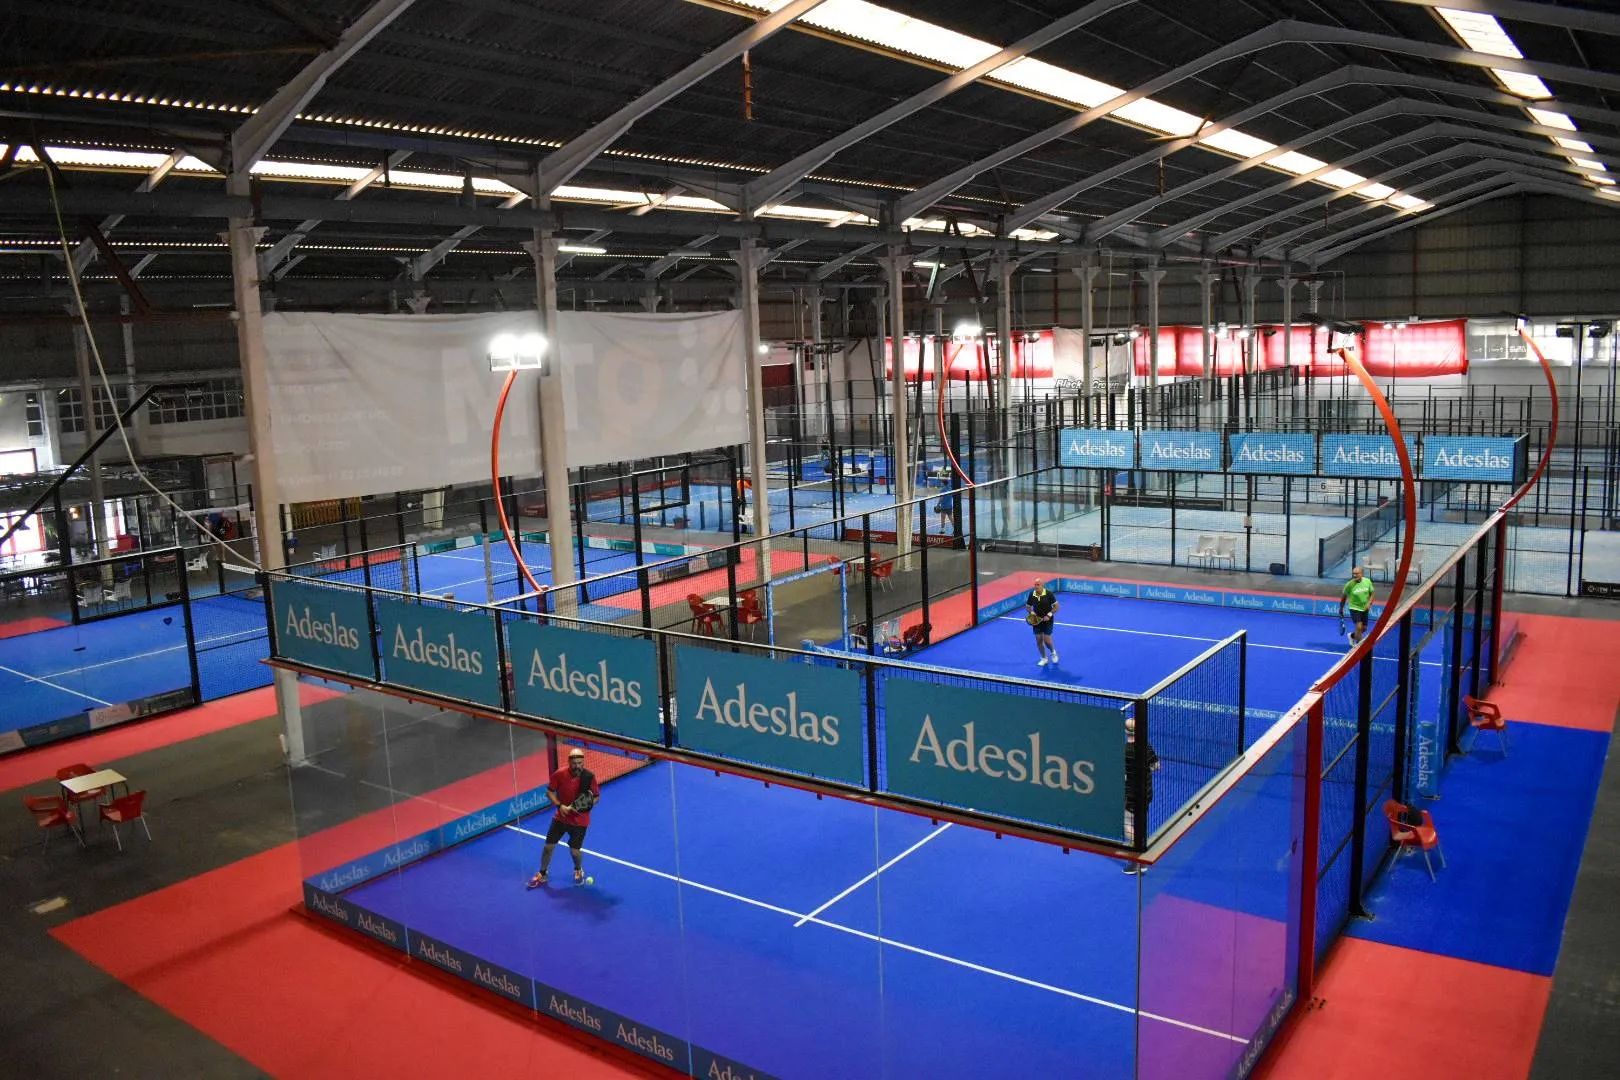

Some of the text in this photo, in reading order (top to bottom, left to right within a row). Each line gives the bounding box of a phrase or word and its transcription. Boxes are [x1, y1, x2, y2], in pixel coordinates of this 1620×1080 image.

[1055, 379, 1084, 389] Black
[1068, 439, 1126, 457] Adeslas
[1151, 441, 1211, 461] Adeslas
[1239, 442, 1304, 462] Adeslas
[1434, 447, 1510, 468] Adeslas
[1066, 580, 1130, 595] Adeslas Adeslas
[1145, 588, 1215, 603] Adeslas Adeslas
[1231, 596, 1305, 610] Adeslas Adeslas
[285, 603, 360, 650] Adeslas
[392, 623, 483, 675] Adeslas
[527, 648, 642, 708] Adeslas
[695, 677, 839, 746] Adeslas
[909, 713, 1095, 794] Adeslas
[1416, 735, 1433, 789] Adeslas
[454, 813, 497, 839] Adeslas
[321, 839, 431, 892] Adeslas Adeslas
[313, 892, 397, 943] Adeslas Adeslas
[420, 940, 521, 997] Adeslas Adeslas
[549, 995, 674, 1061] Adeslas Adeslas
